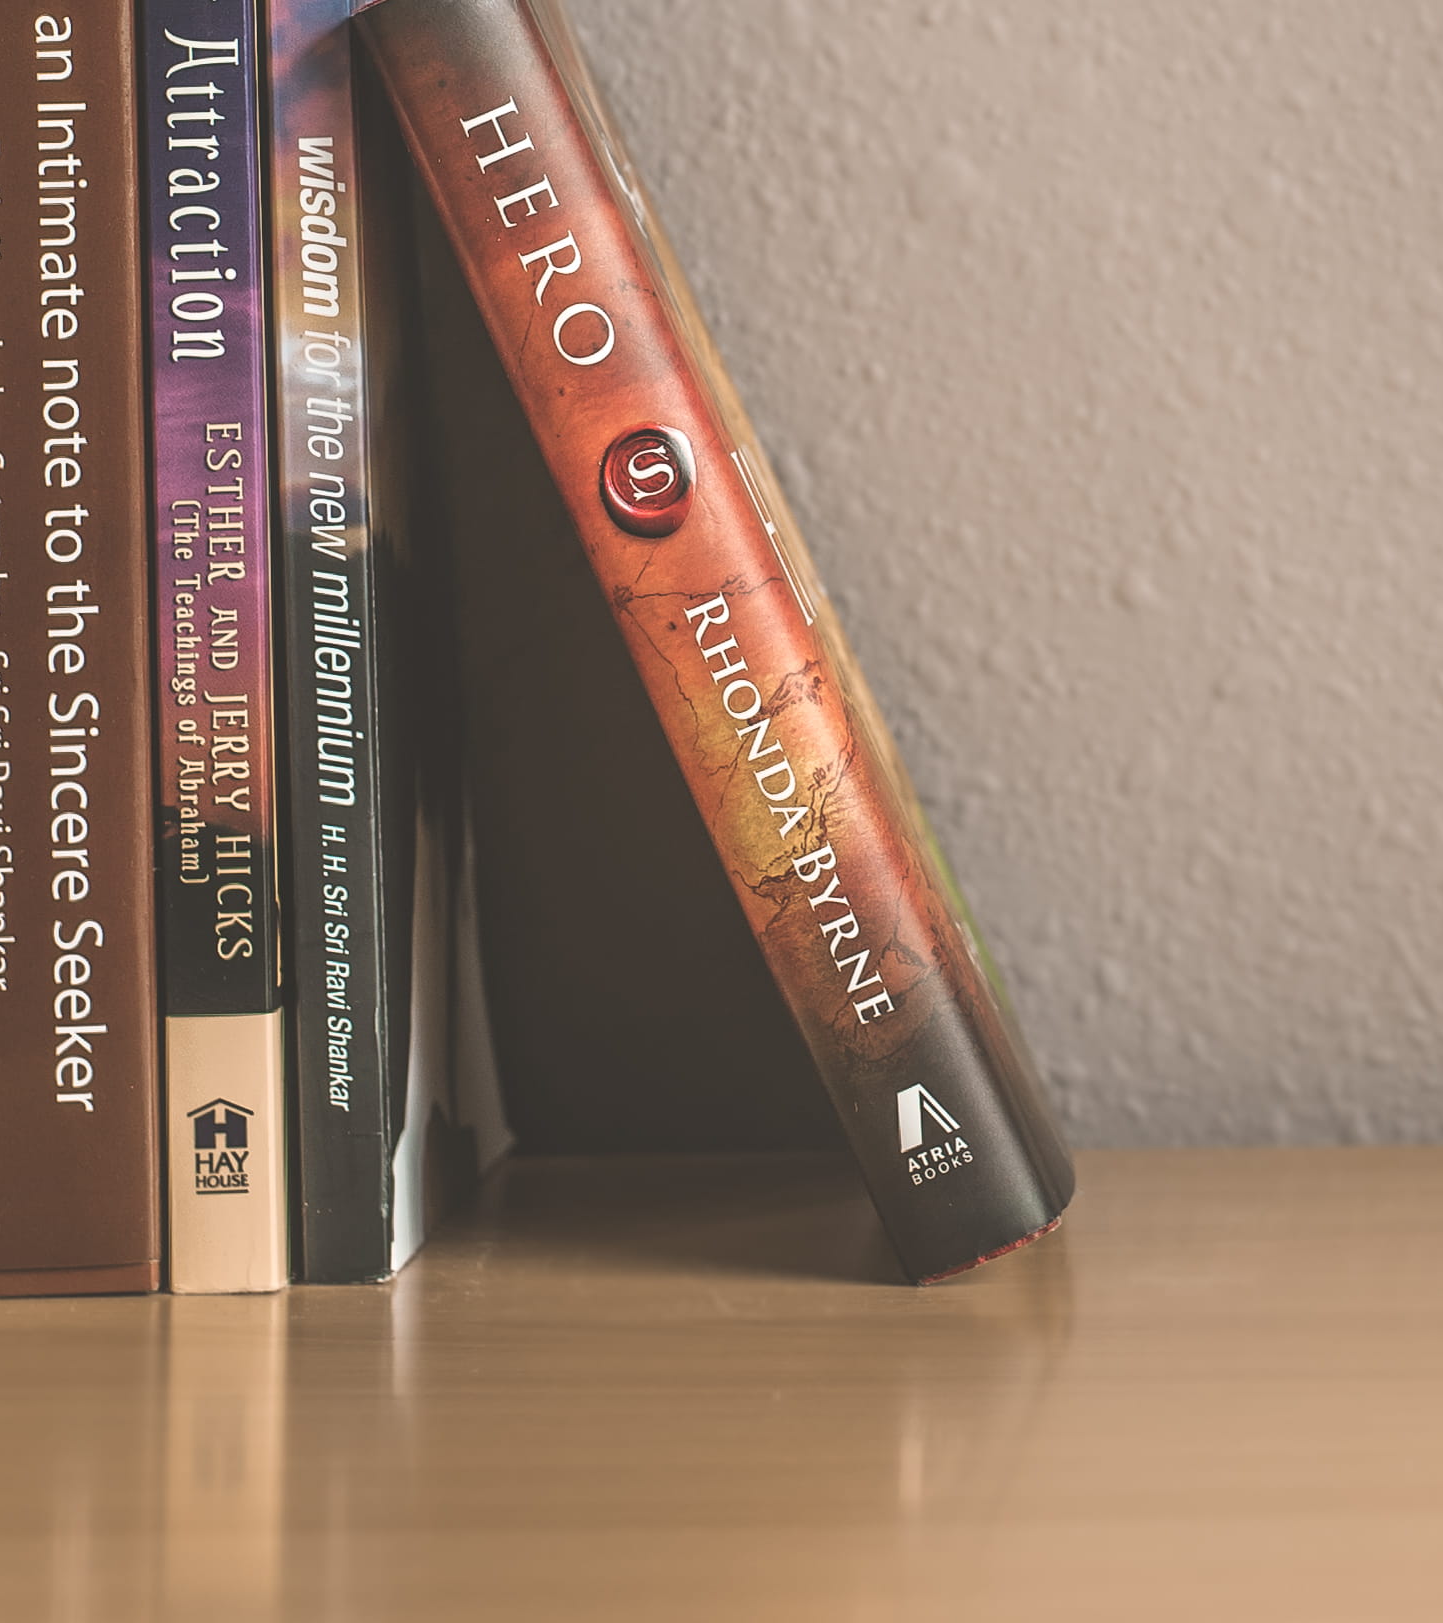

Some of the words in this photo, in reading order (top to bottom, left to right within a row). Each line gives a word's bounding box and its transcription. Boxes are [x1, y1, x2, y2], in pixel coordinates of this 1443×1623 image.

[33, 14, 74, 82] an
[36, 101, 89, 341] Intimate
[163, 27, 240, 363] Attraction
[297, 136, 348, 319] wisdom
[458, 93, 619, 367] HERO
[302, 327, 351, 386] for
[41, 358, 89, 489] note
[305, 396, 355, 461] the
[43, 502, 90, 564] to
[170, 499, 203, 561] (The
[205, 421, 246, 587] ESTHER
[307, 470, 348, 561] new
[45, 578, 99, 675] the
[170, 572, 204, 707] Teachings
[209, 604, 240, 671] AND
[177, 718, 207, 747] of
[311, 569, 365, 807] millennium
[203, 689, 252, 813] JERRY
[47, 691, 100, 903] Sincere
[177, 754, 211, 885] Abraham)
[320, 823, 347, 848] H.
[683, 591, 812, 840] RHONDA
[791, 840, 897, 1026] BYRNE
[214, 833, 253, 961] HICKS
[321, 853, 348, 878] H.
[322, 883, 350, 918] Sri
[323, 921, 351, 956] Sri
[52, 919, 108, 1113] Seeker
[324, 959, 351, 1011] Ravi
[326, 1014, 355, 1113] Shankar
[194, 1151, 250, 1174] HAY
[194, 1173, 250, 1189] HOUSE
[906, 1136, 971, 1175] ATRIA
[911, 1150, 975, 1187] BOOKS
